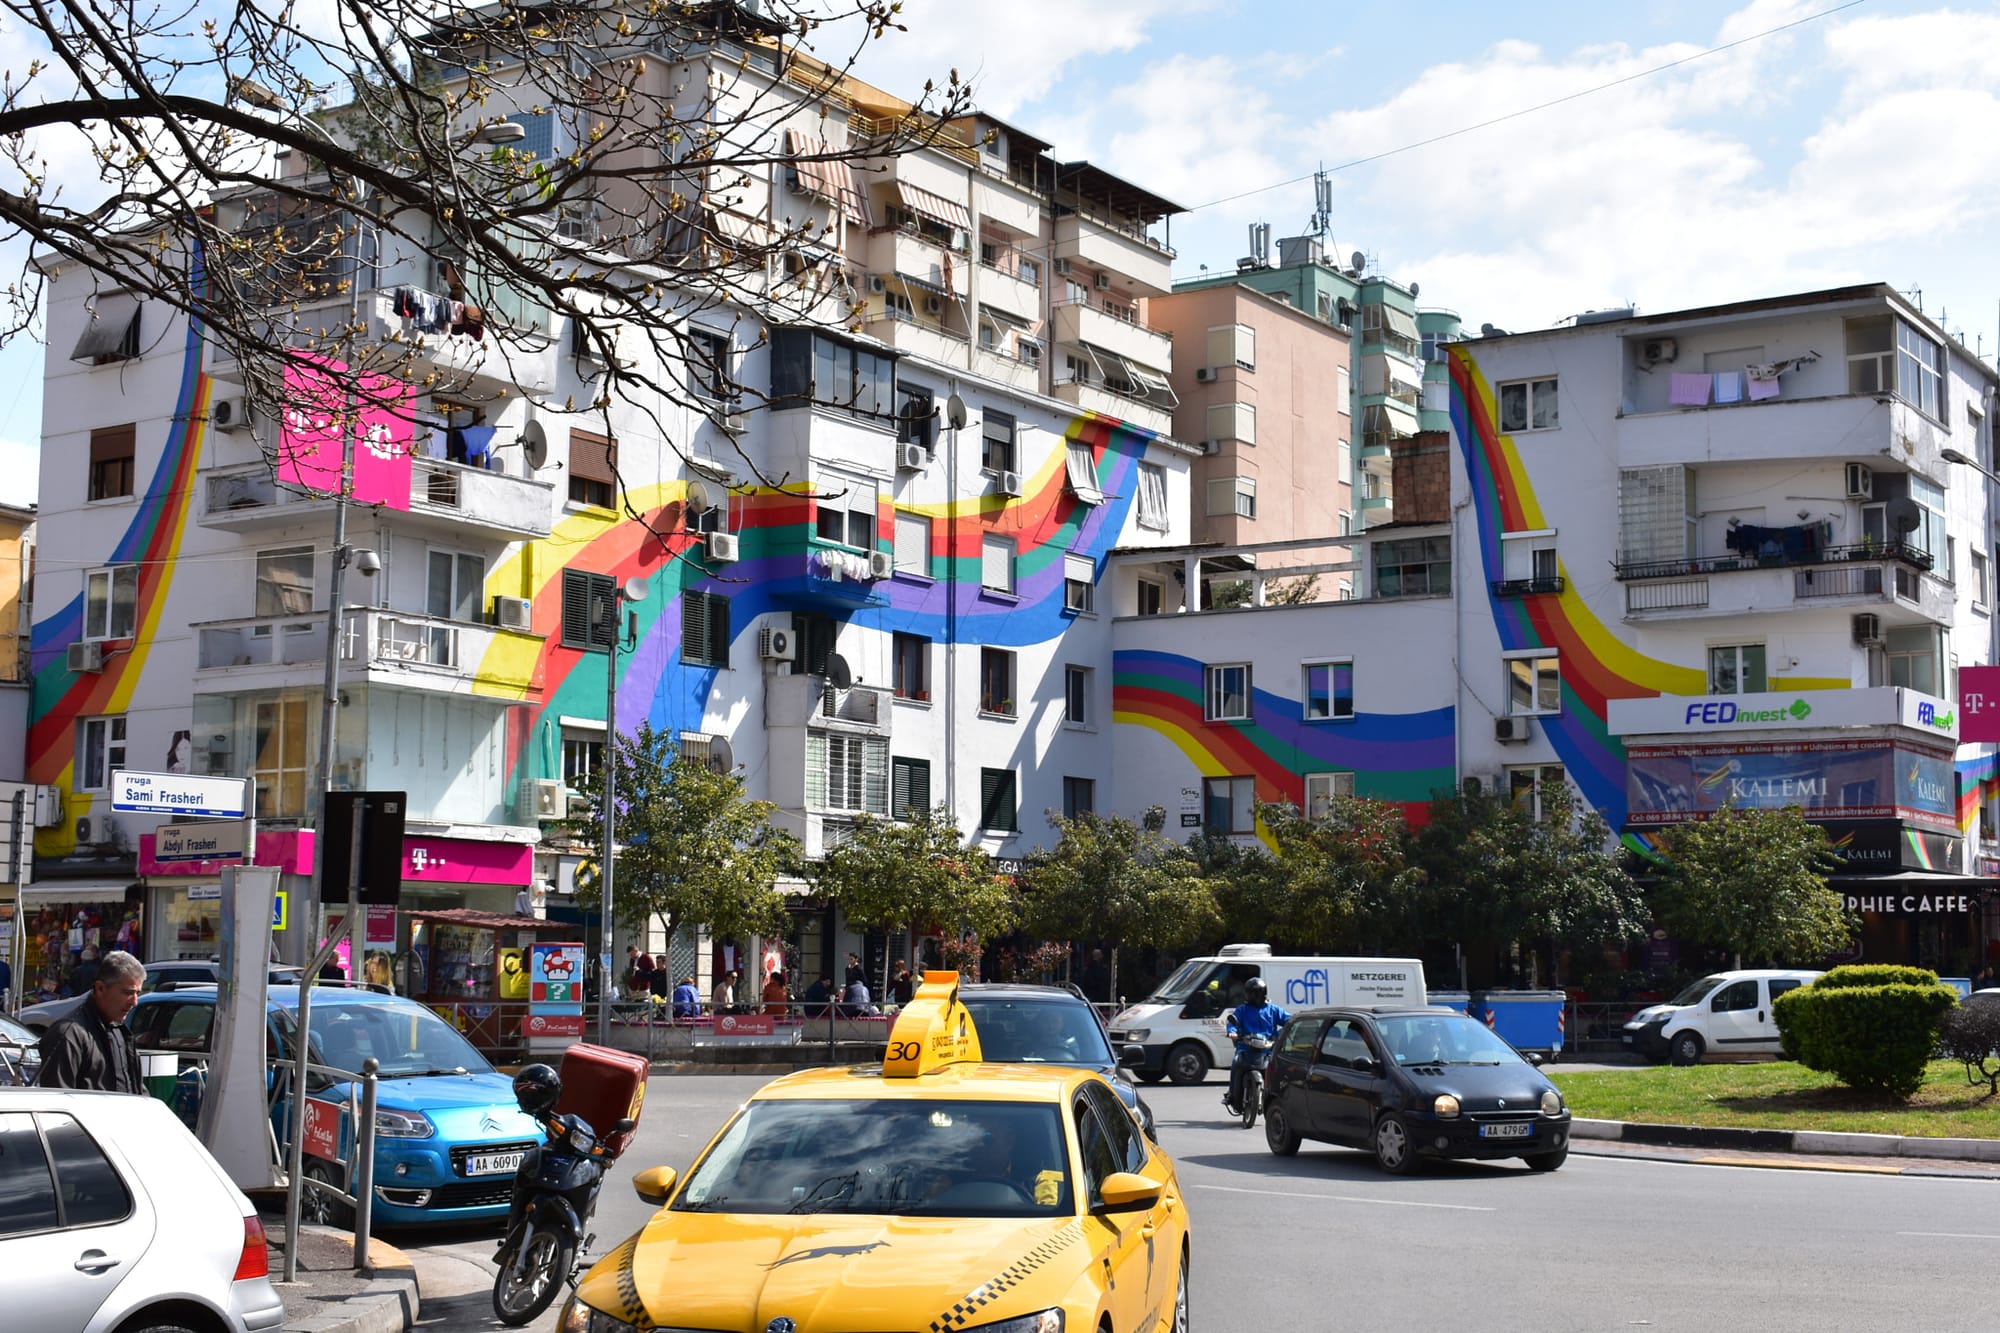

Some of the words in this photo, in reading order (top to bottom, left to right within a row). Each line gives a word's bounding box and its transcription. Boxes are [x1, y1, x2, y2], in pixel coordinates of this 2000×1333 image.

[126, 776, 151, 786] rruga
[1731, 777, 1829, 798] KALEMI
[126, 788, 153, 801] Sami
[159, 790, 204, 805] Frasheri
[163, 839, 183, 853] Abdyl
[187, 838, 217, 850] Frasheri
[1847, 849, 1892, 860] KALEMI
[1902, 895, 1968, 913] CAFFE
[1351, 973, 1406, 981] METZGEREI
[887, 1041, 921, 1061] 30
[1487, 1126, 1498, 1136] AA
[475, 1157, 488, 1171] AA
